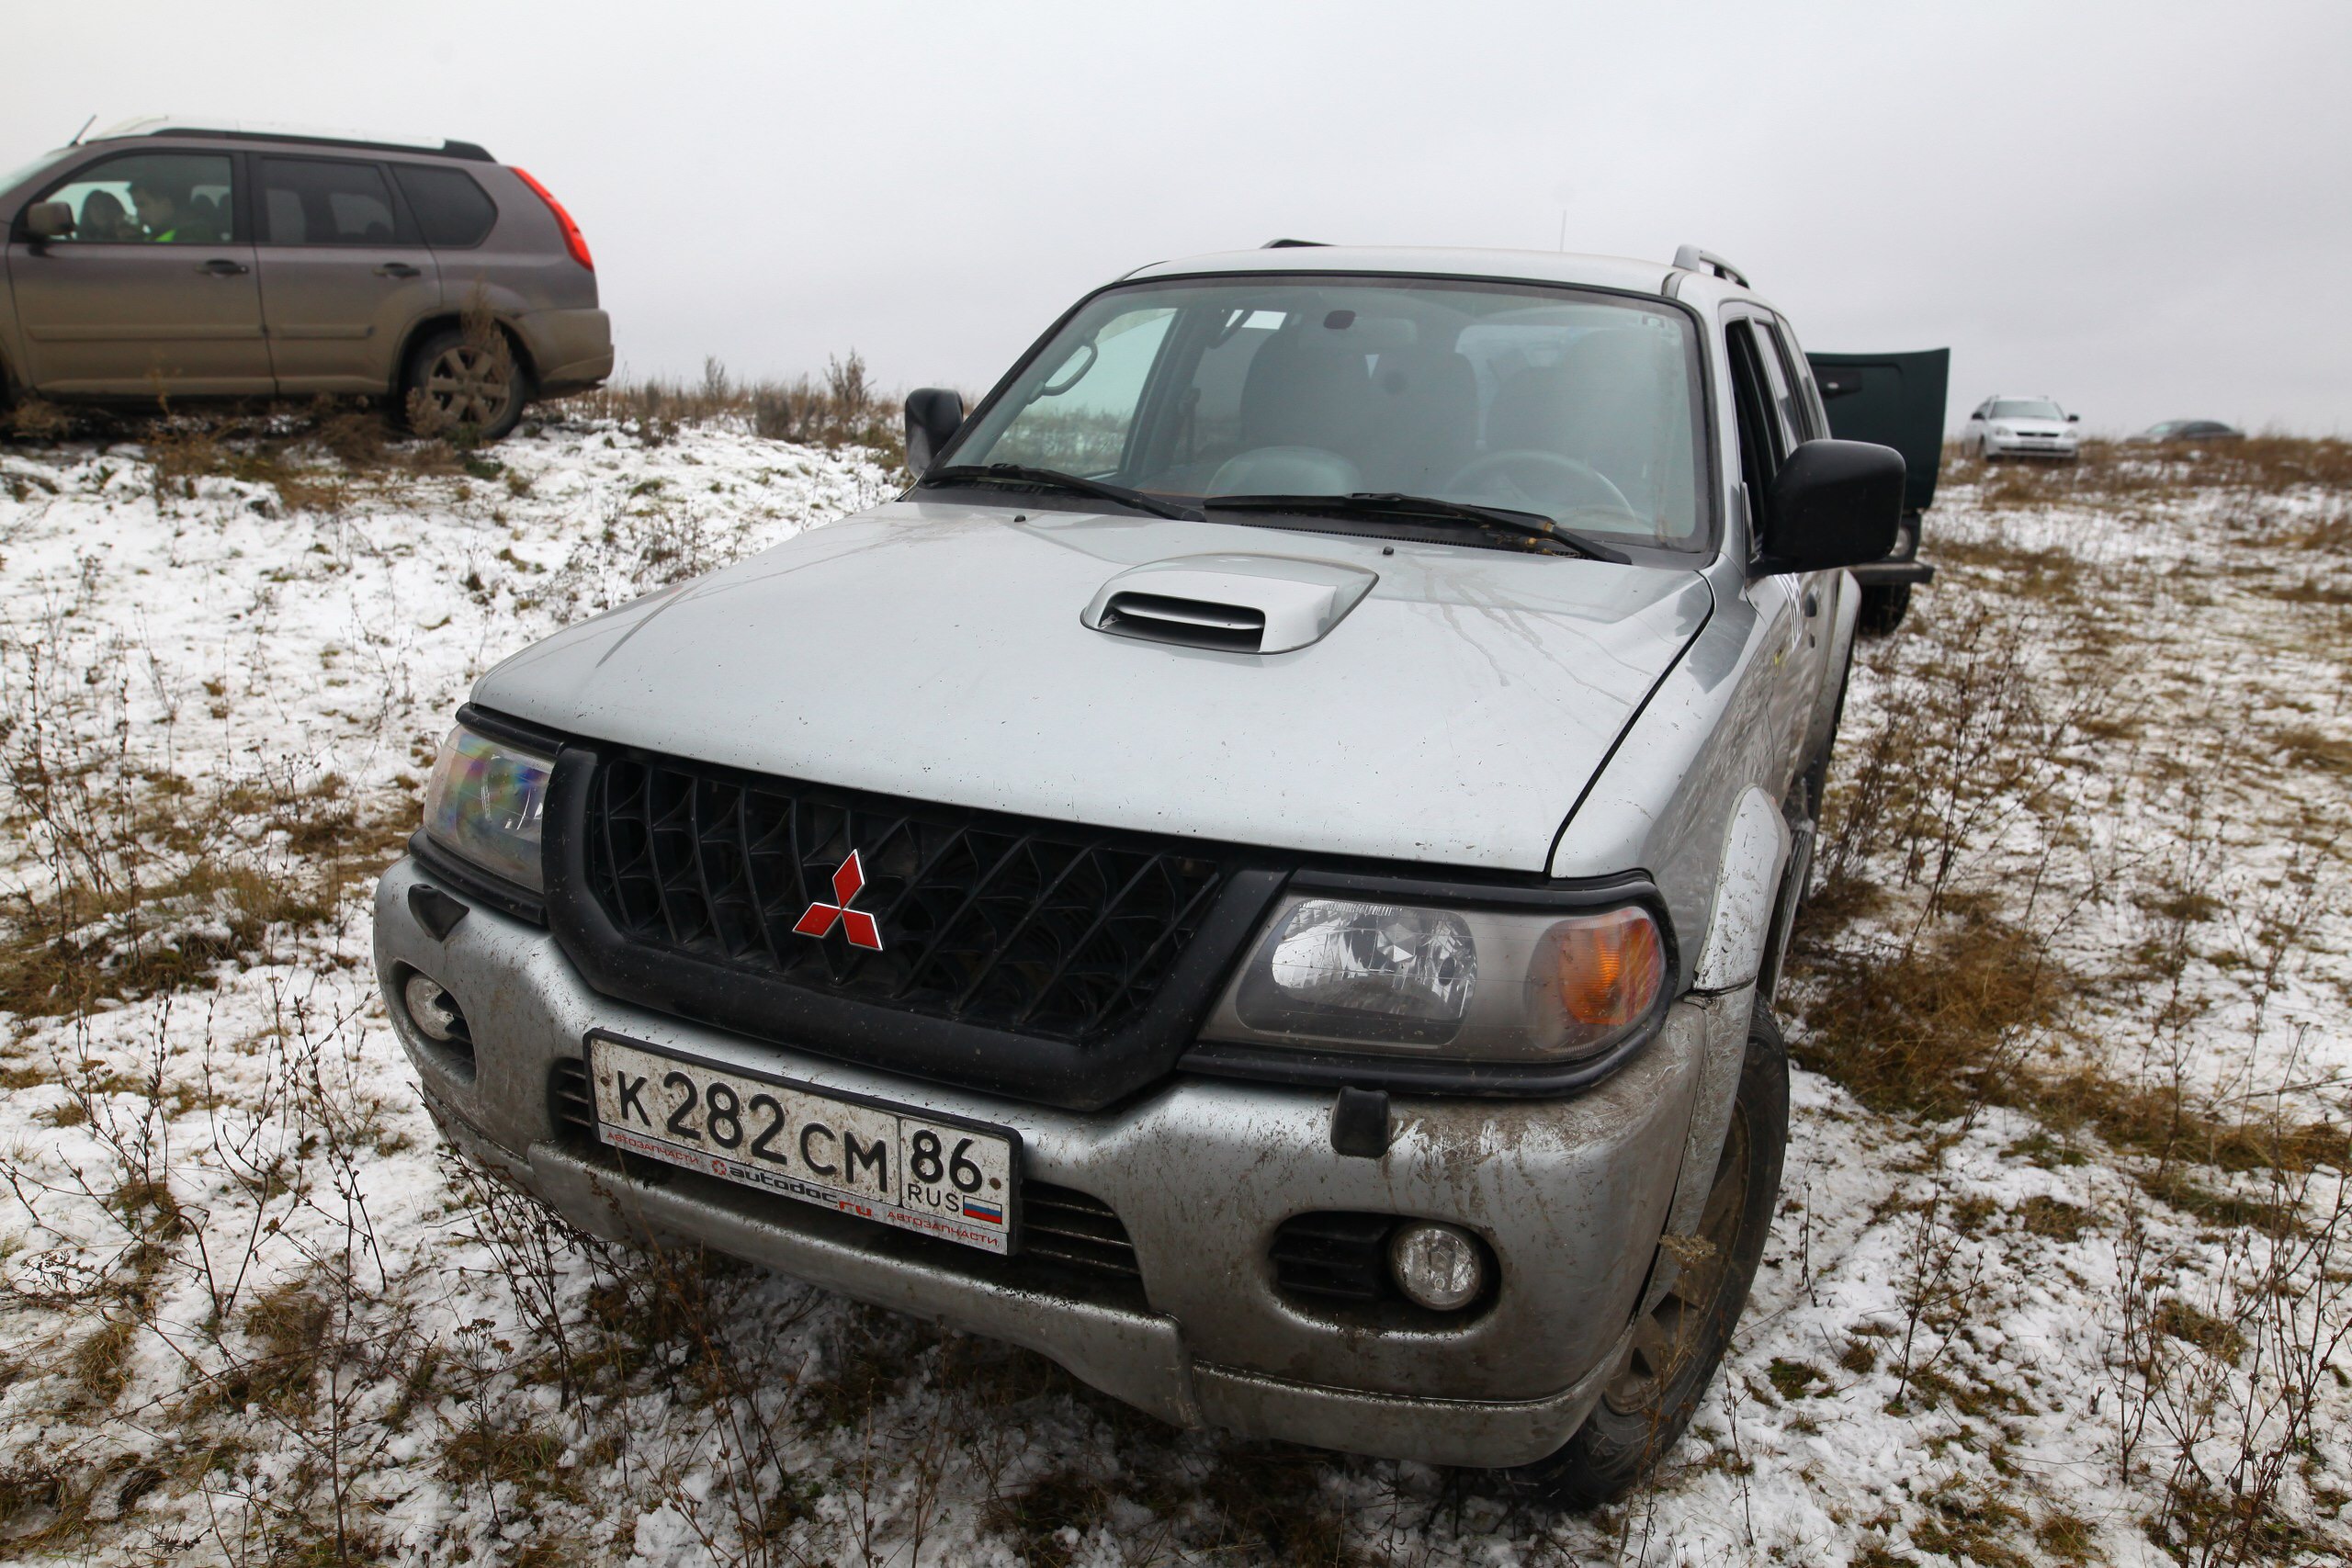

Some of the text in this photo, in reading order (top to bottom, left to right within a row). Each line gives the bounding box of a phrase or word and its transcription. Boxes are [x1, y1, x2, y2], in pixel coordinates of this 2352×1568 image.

[607, 1131, 699, 1164] АВТОЗАПЧАСТИ
[910, 1128, 983, 1193] 86
[907, 1182, 960, 1213] RUS
[887, 1211, 999, 1247] АВТОЗАПЧАСТИ
